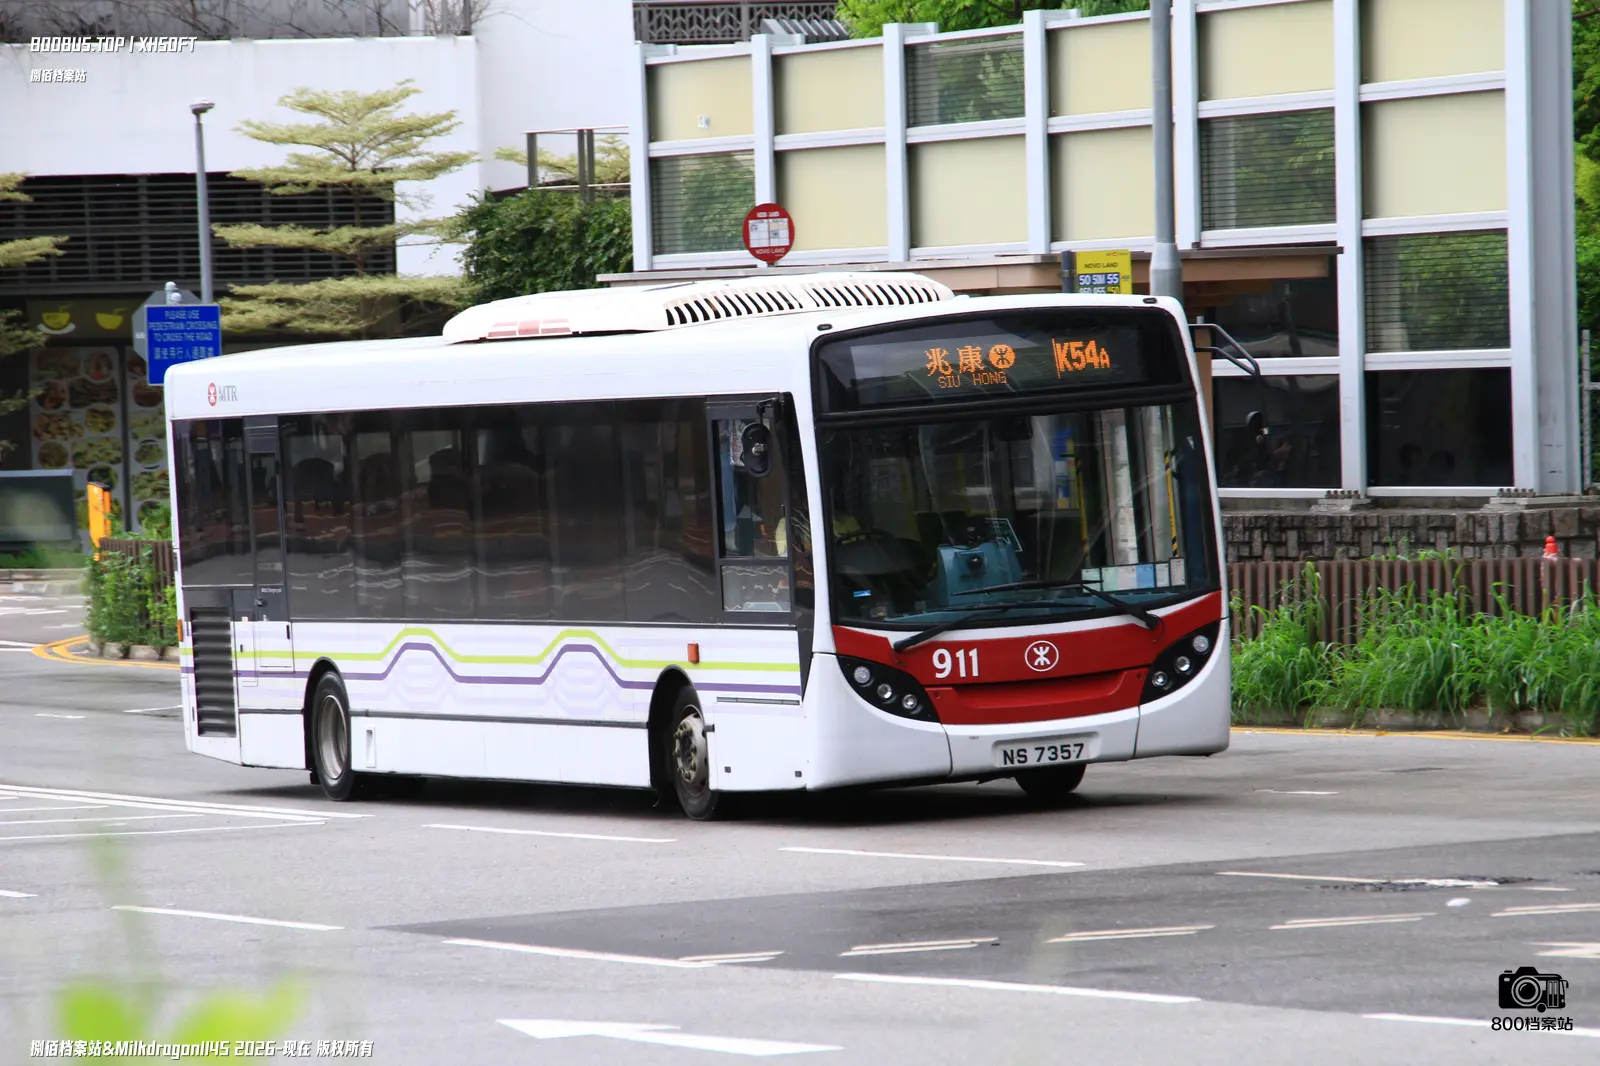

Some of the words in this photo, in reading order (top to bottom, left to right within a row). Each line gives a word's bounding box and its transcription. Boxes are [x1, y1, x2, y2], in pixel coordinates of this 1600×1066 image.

[1078, 274, 1091, 285] 50
[1106, 273, 1119, 284] 55
[164, 310, 186, 319] PLEASE
[187, 310, 200, 319] USE
[148, 321, 185, 330] PEDESTRIAN
[186, 321, 218, 330] CROSSING
[153, 332, 162, 341] TO
[162, 332, 183, 341] CROSS
[183, 332, 195, 341] THE
[195, 331, 213, 341] ROAD
[925, 345, 984, 377] 兆康
[1055, 340, 1111, 372] K54A
[938, 374, 961, 388] SIU
[972, 371, 1008, 386] HONG
[218, 385, 238, 402] MTR
[932, 648, 979, 679] 911
[1003, 748, 1028, 766] NS
[1034, 743, 1085, 763] 7357
